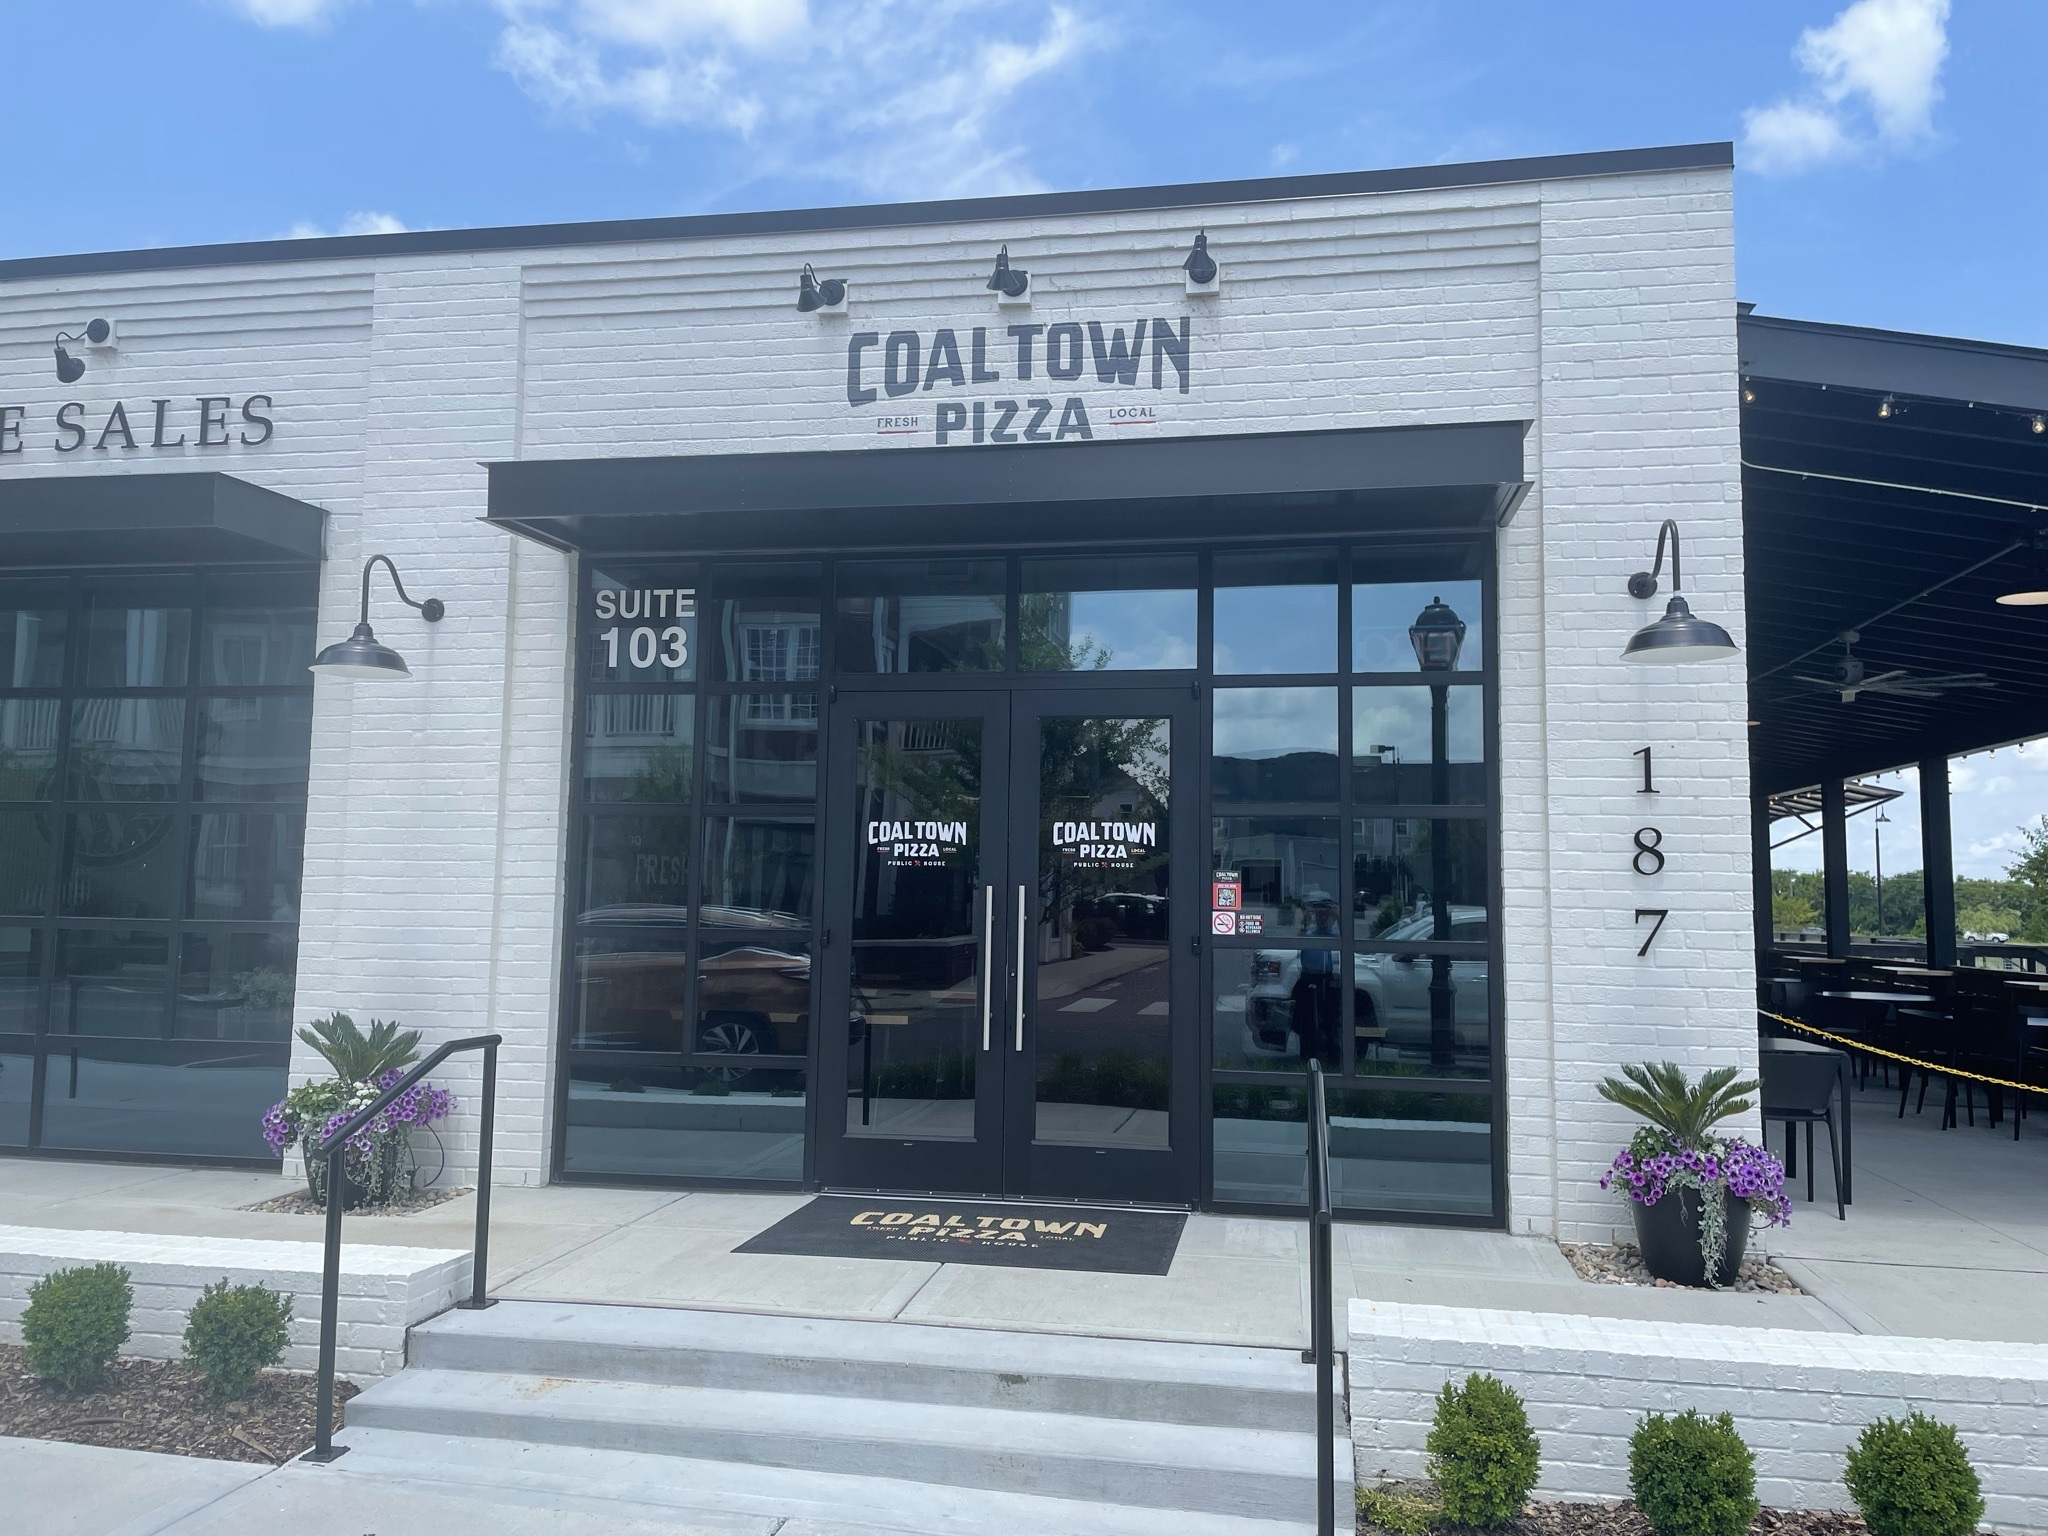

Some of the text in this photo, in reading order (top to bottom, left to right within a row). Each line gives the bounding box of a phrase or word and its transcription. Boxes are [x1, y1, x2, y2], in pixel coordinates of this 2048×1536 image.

[1109, 406, 1156, 419] LOCAL
[54, 394, 274, 453] SALES
[877, 416, 918, 428] FRESH
[935, 397, 1094, 445] PIZZA
[595, 588, 696, 619] SUITE
[600, 626, 688, 669] 103
[893, 843, 940, 857] PIZZA
[1079, 844, 1128, 859] PIZZA
[907, 1226, 1027, 1241] PIZZA
